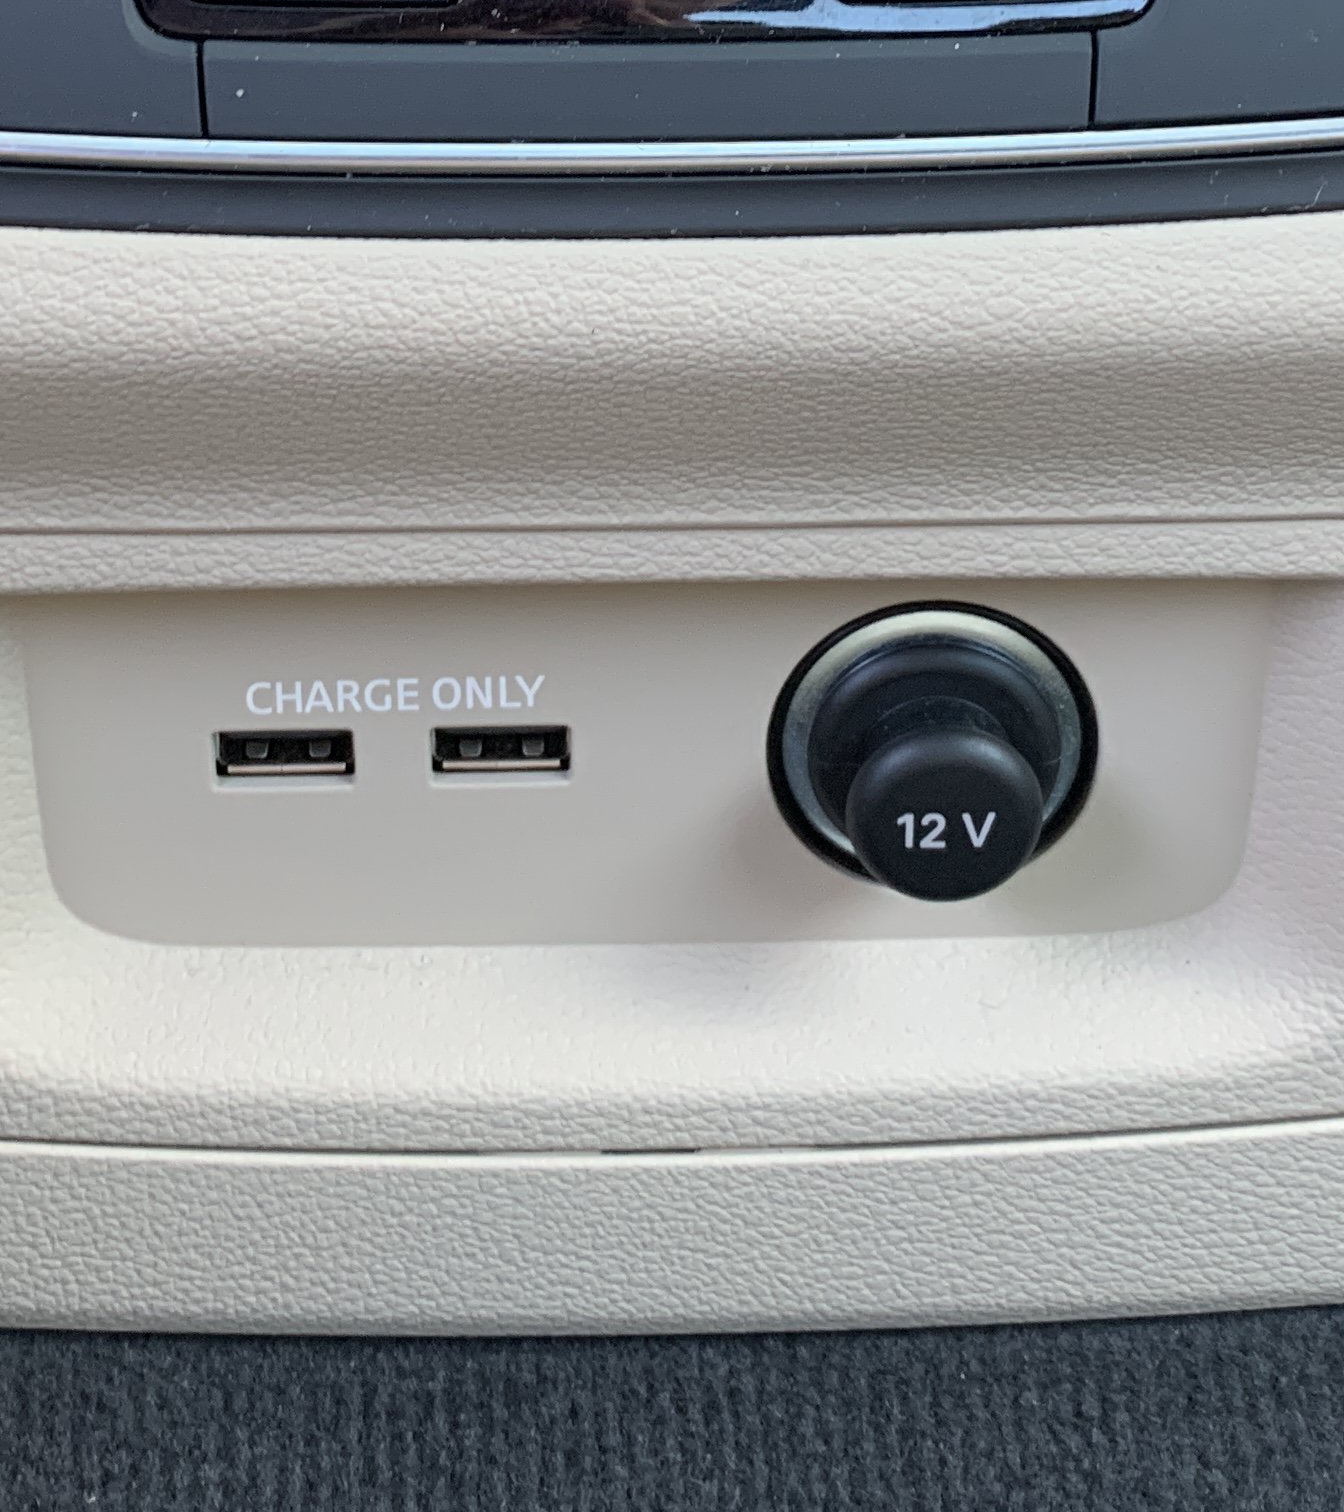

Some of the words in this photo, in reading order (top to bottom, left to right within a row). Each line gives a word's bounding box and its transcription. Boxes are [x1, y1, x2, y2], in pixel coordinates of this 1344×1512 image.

[246, 679, 420, 714] CHARGE
[432, 675, 545, 710] ONLY
[896, 812, 947, 849] 12
[961, 811, 997, 848] V
